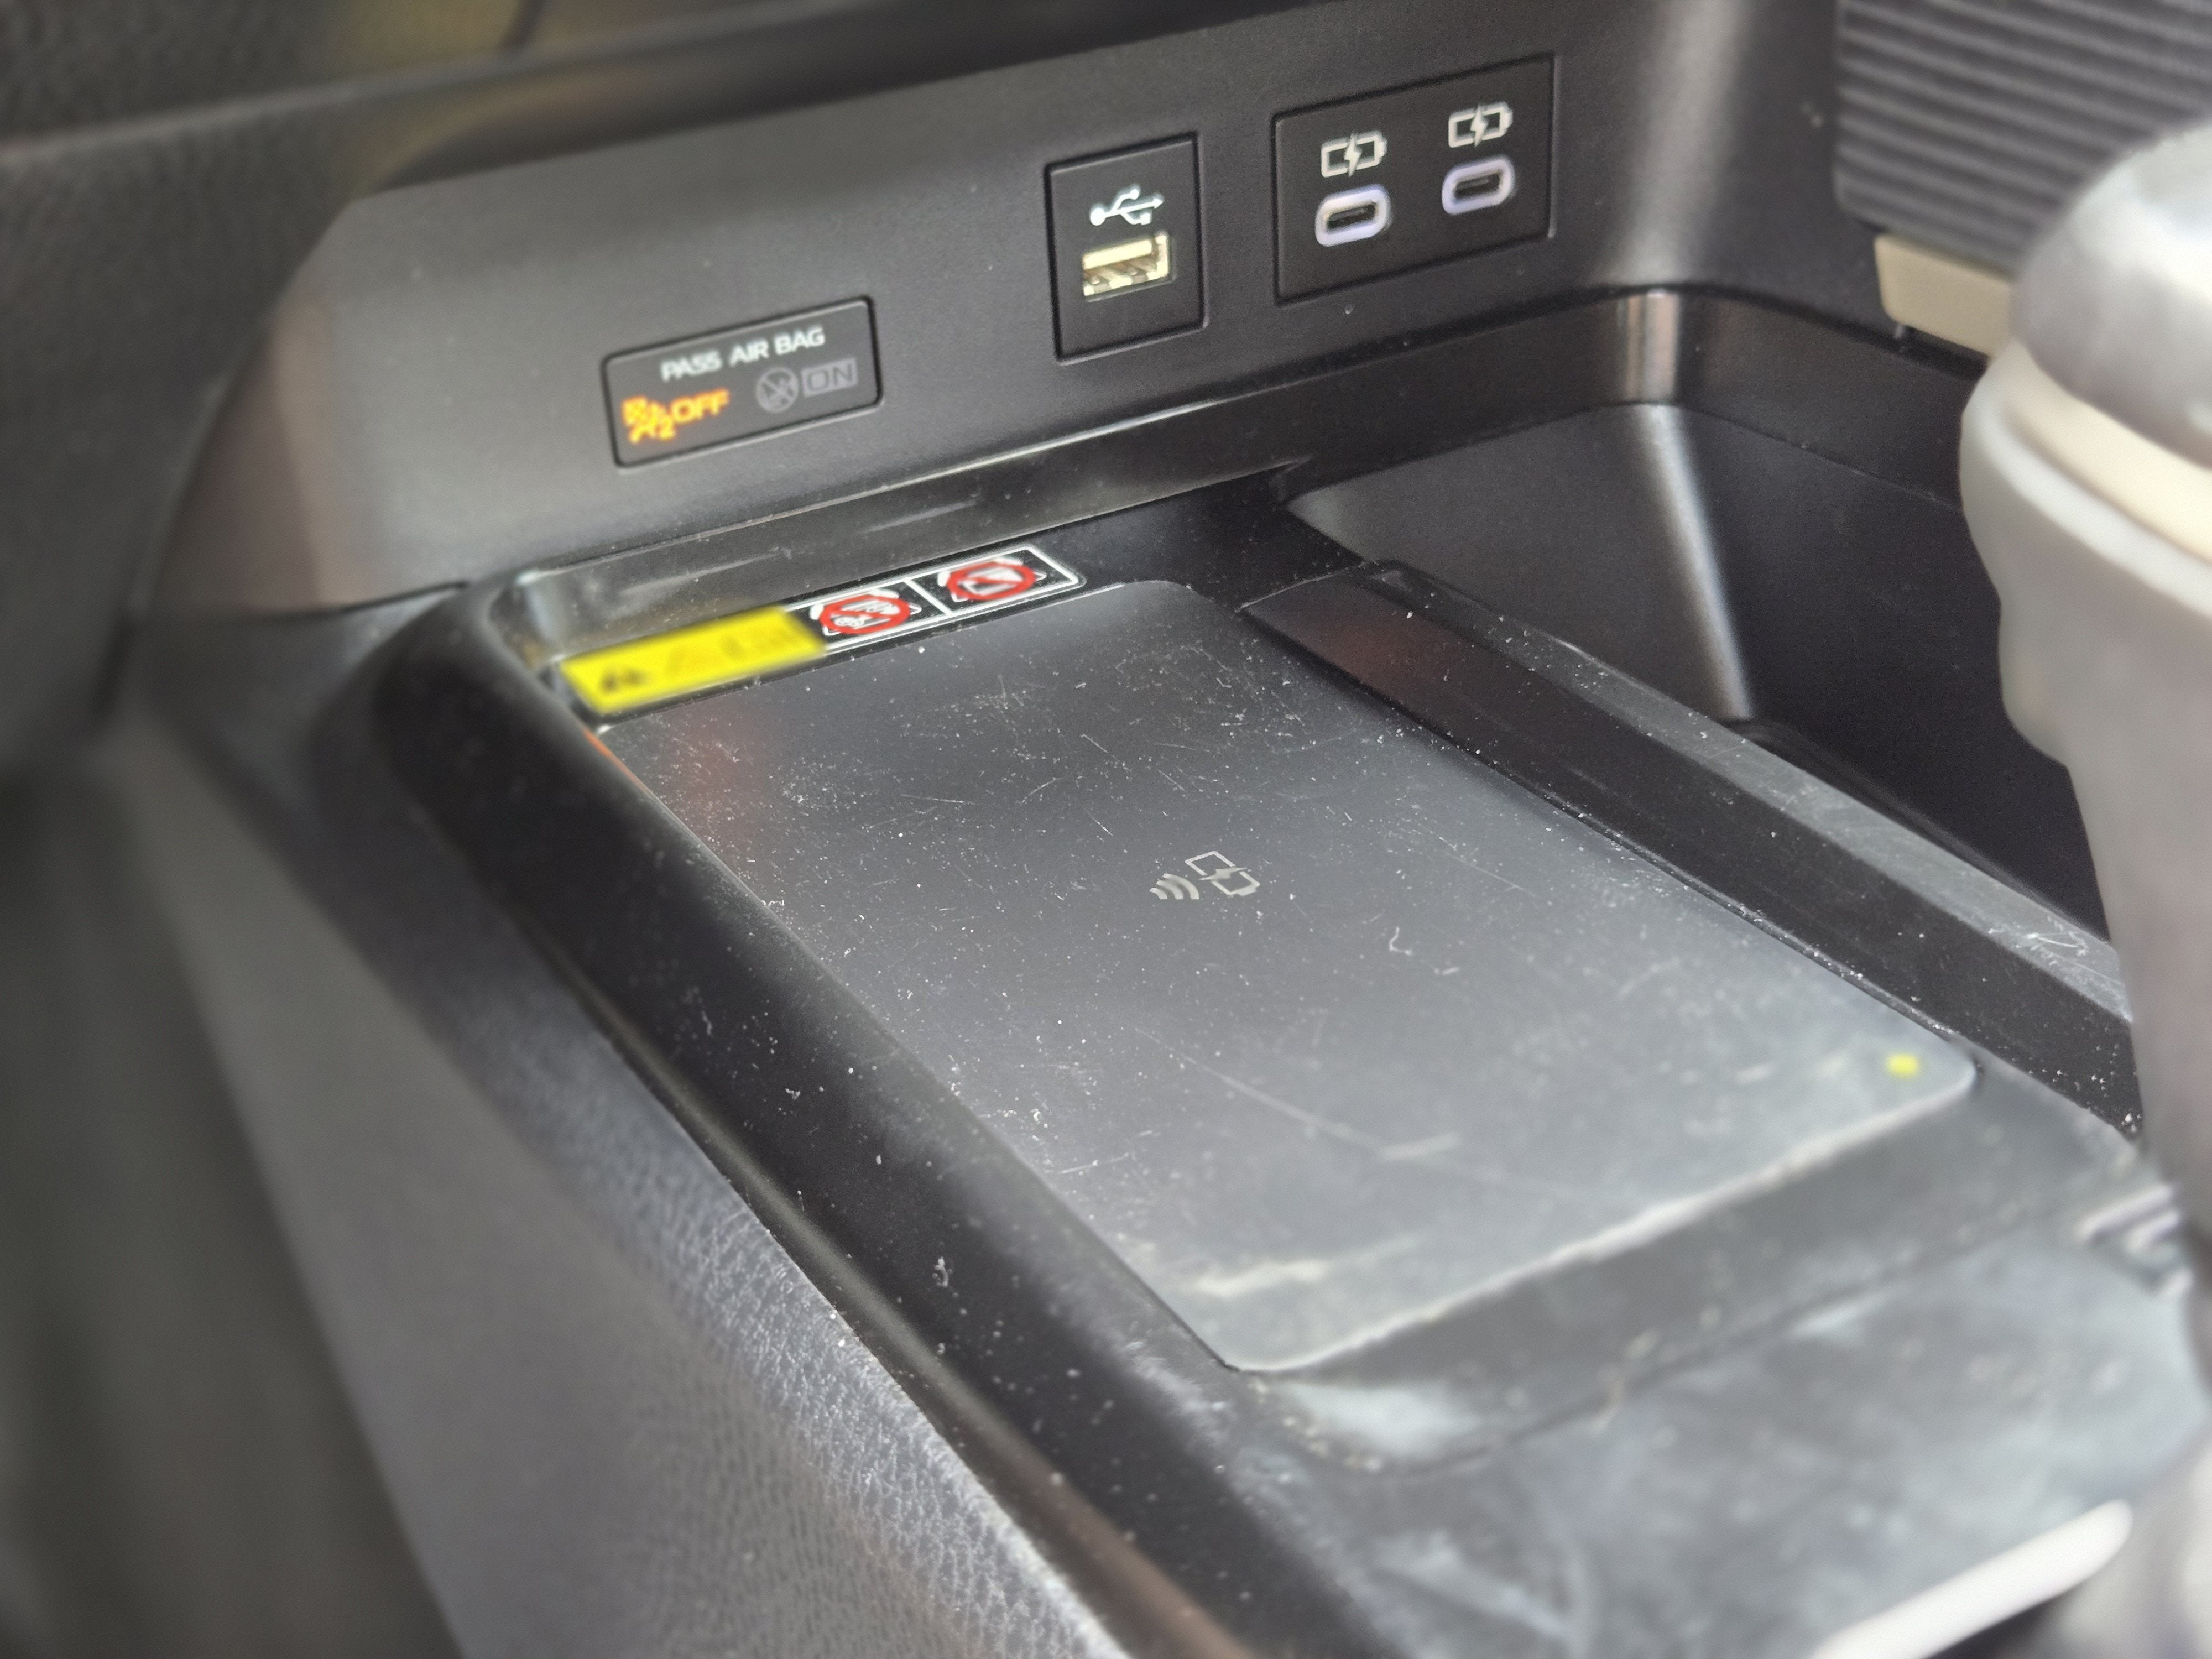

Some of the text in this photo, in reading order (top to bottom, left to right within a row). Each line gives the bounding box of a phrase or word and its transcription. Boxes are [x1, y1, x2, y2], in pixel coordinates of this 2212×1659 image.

[660, 325, 826, 382] PASS AIR BAG
[805, 359, 855, 392] ON
[670, 388, 730, 425] OFF
